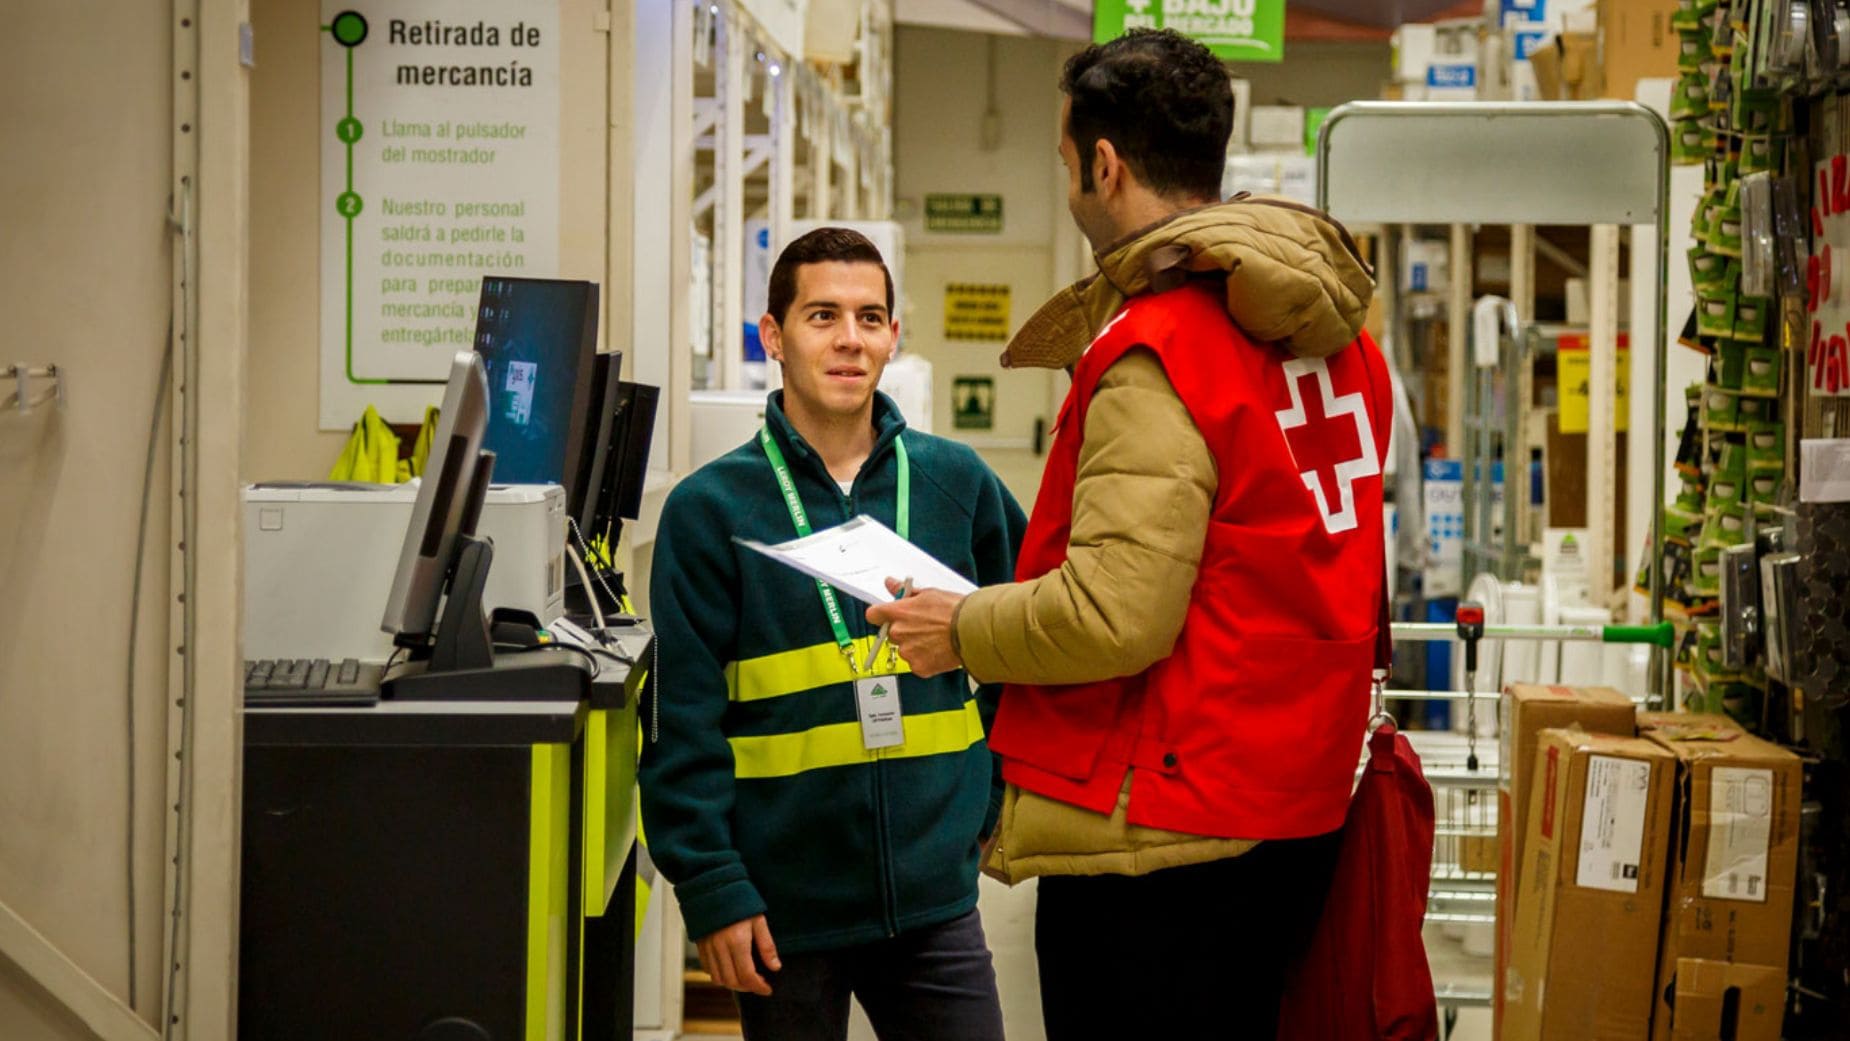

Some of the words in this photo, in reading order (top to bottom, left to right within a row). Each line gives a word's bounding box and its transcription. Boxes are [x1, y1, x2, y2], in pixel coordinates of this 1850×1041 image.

[389, 19, 500, 47] Retirada
[510, 22, 540, 47] de
[397, 61, 533, 87] mercancía
[346, 123, 355, 139] 1
[382, 119, 431, 138] Llama
[436, 121, 450, 139] al
[456, 121, 527, 142] pulsador
[382, 145, 405, 163] del
[411, 146, 495, 164] mostrador
[346, 196, 357, 213] 2
[382, 198, 446, 217] Nuestro
[455, 199, 524, 220] personal
[382, 224, 431, 242] saldrá
[436, 228, 446, 242] a
[451, 226, 505, 245] pedirle
[511, 226, 524, 243] la
[382, 250, 524, 268] documentación
[382, 278, 417, 295] para
[428, 278, 481, 295] prepar
[382, 300, 464, 318] mercancía
